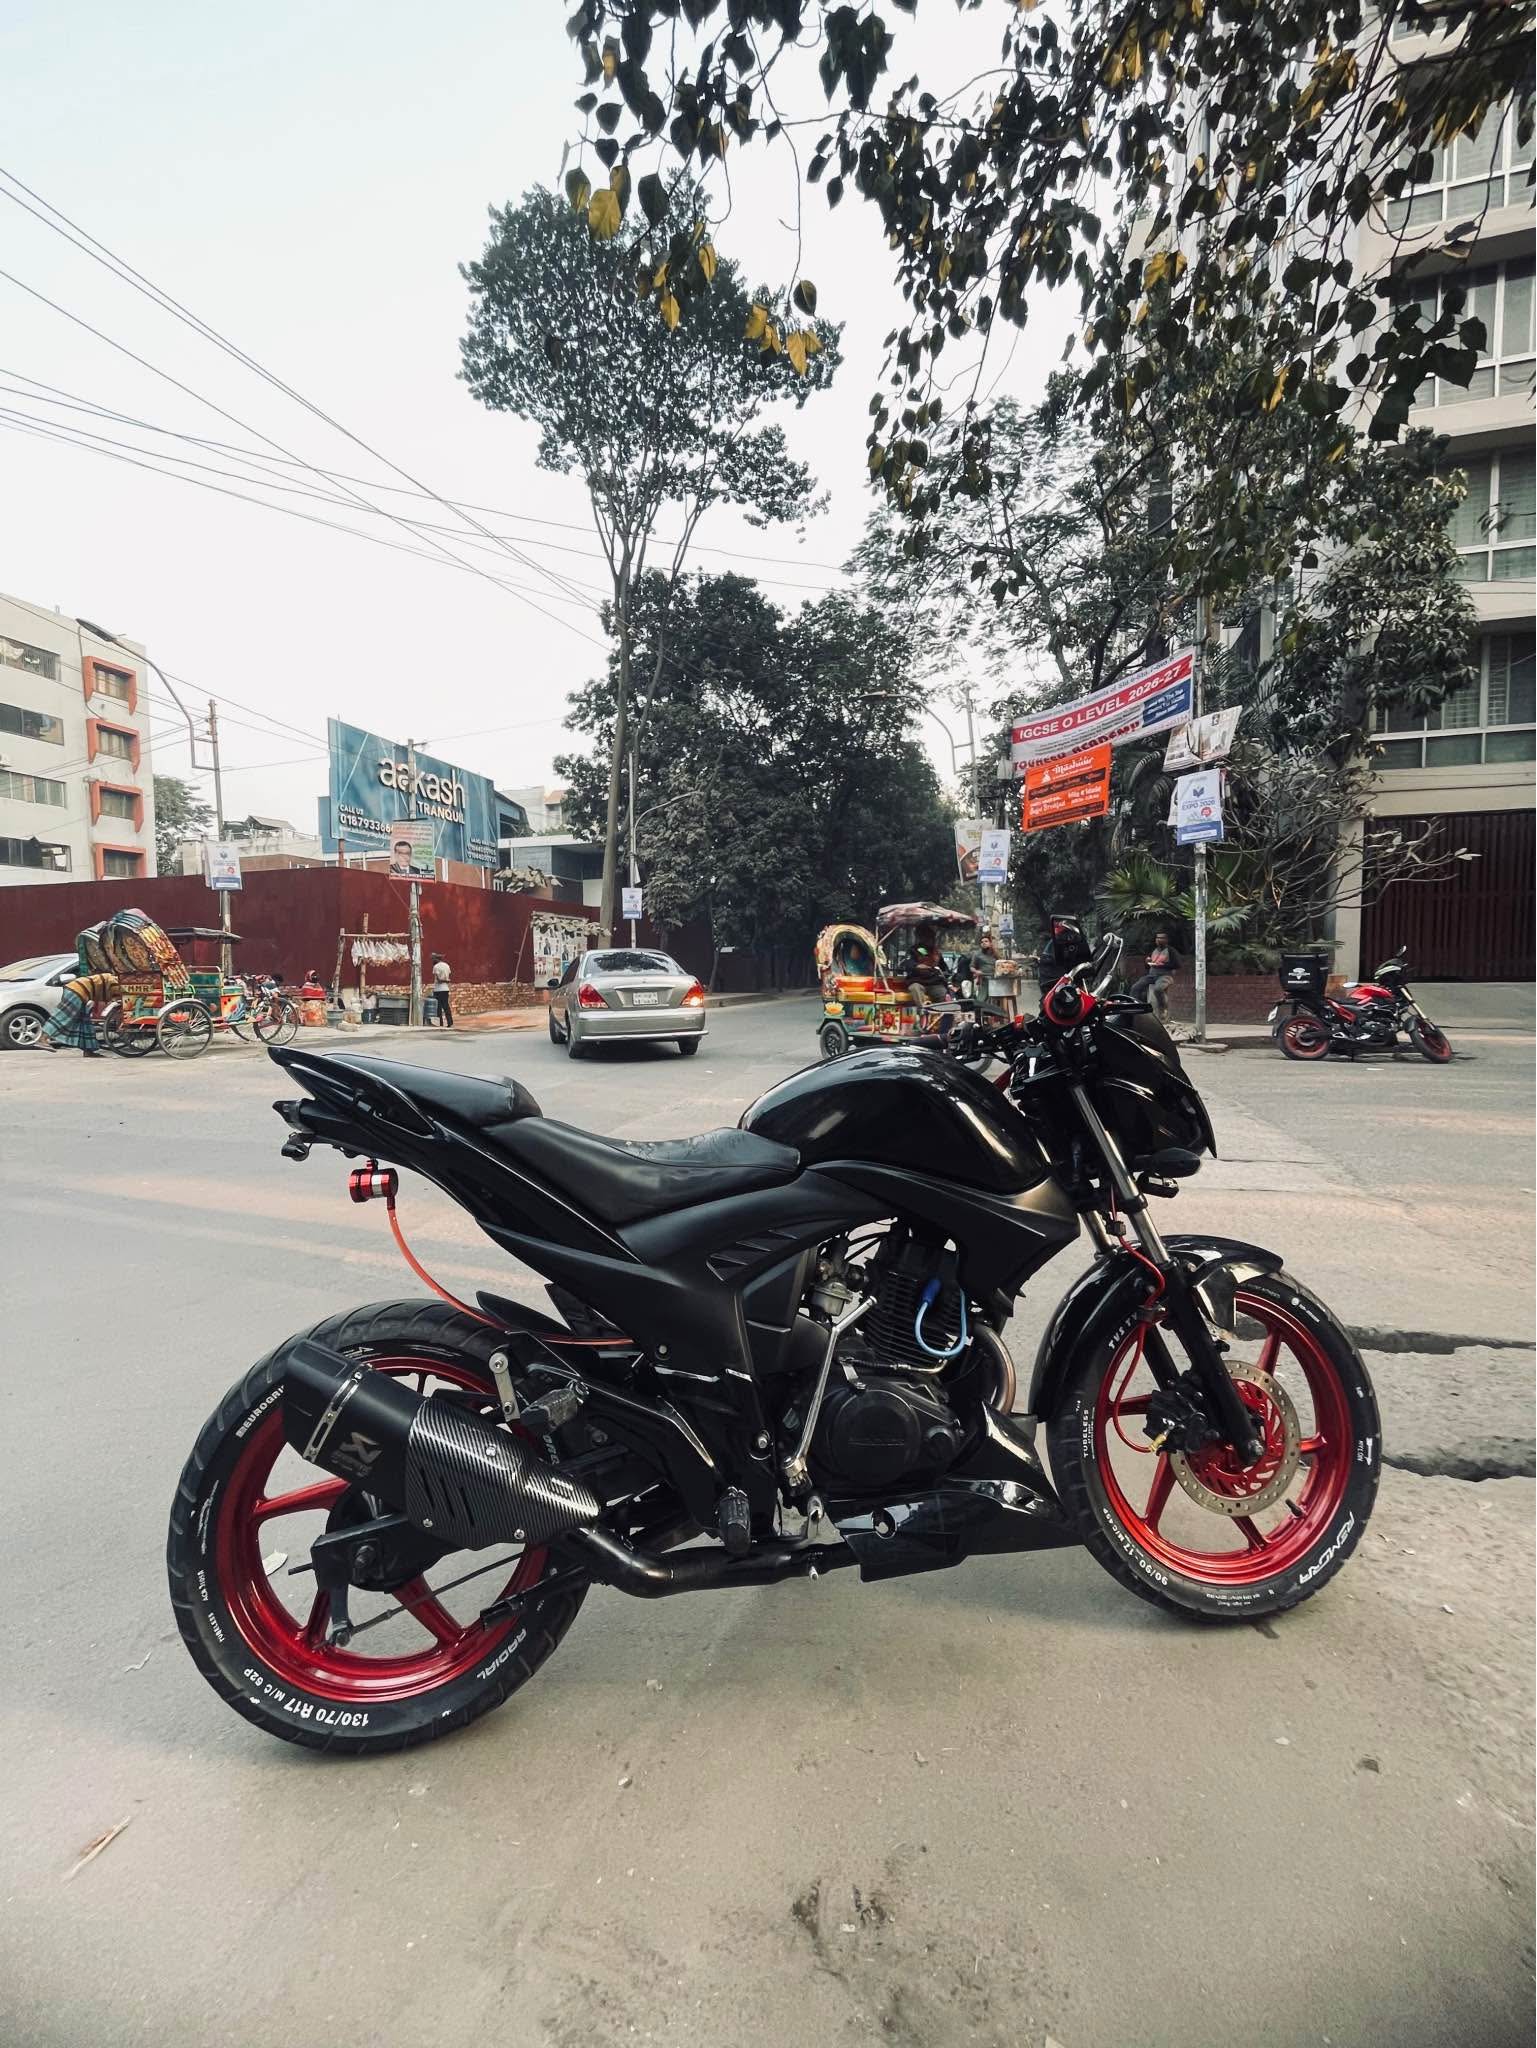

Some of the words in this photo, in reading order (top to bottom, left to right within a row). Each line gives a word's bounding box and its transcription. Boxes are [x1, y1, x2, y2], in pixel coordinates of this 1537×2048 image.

[1019, 722, 1059, 740] IGCSE
[1062, 717, 1073, 729] O
[1076, 698, 1125, 725] LEVEL
[1128, 664, 1181, 702] 2026-27
[379, 757, 466, 809] aakash
[339, 804, 356, 815] CALL
[417, 801, 465, 825] TRANQUIL
[1182, 801, 1199, 811] EXPO
[1108, 1325, 1125, 1350] TVS
[242, 1384, 285, 1429] EUROGRI
[1122, 1543, 1135, 1556] 17
[1299, 1510, 1356, 1585] REMORA
[1139, 1559, 1169, 1586] 90/90
[476, 1629, 527, 1680] RADIAL
[243, 1667, 264, 1687] 62P
[263, 1684, 286, 1702] M/C
[283, 1698, 315, 1719] R17
[316, 1709, 369, 1727] 130/70
